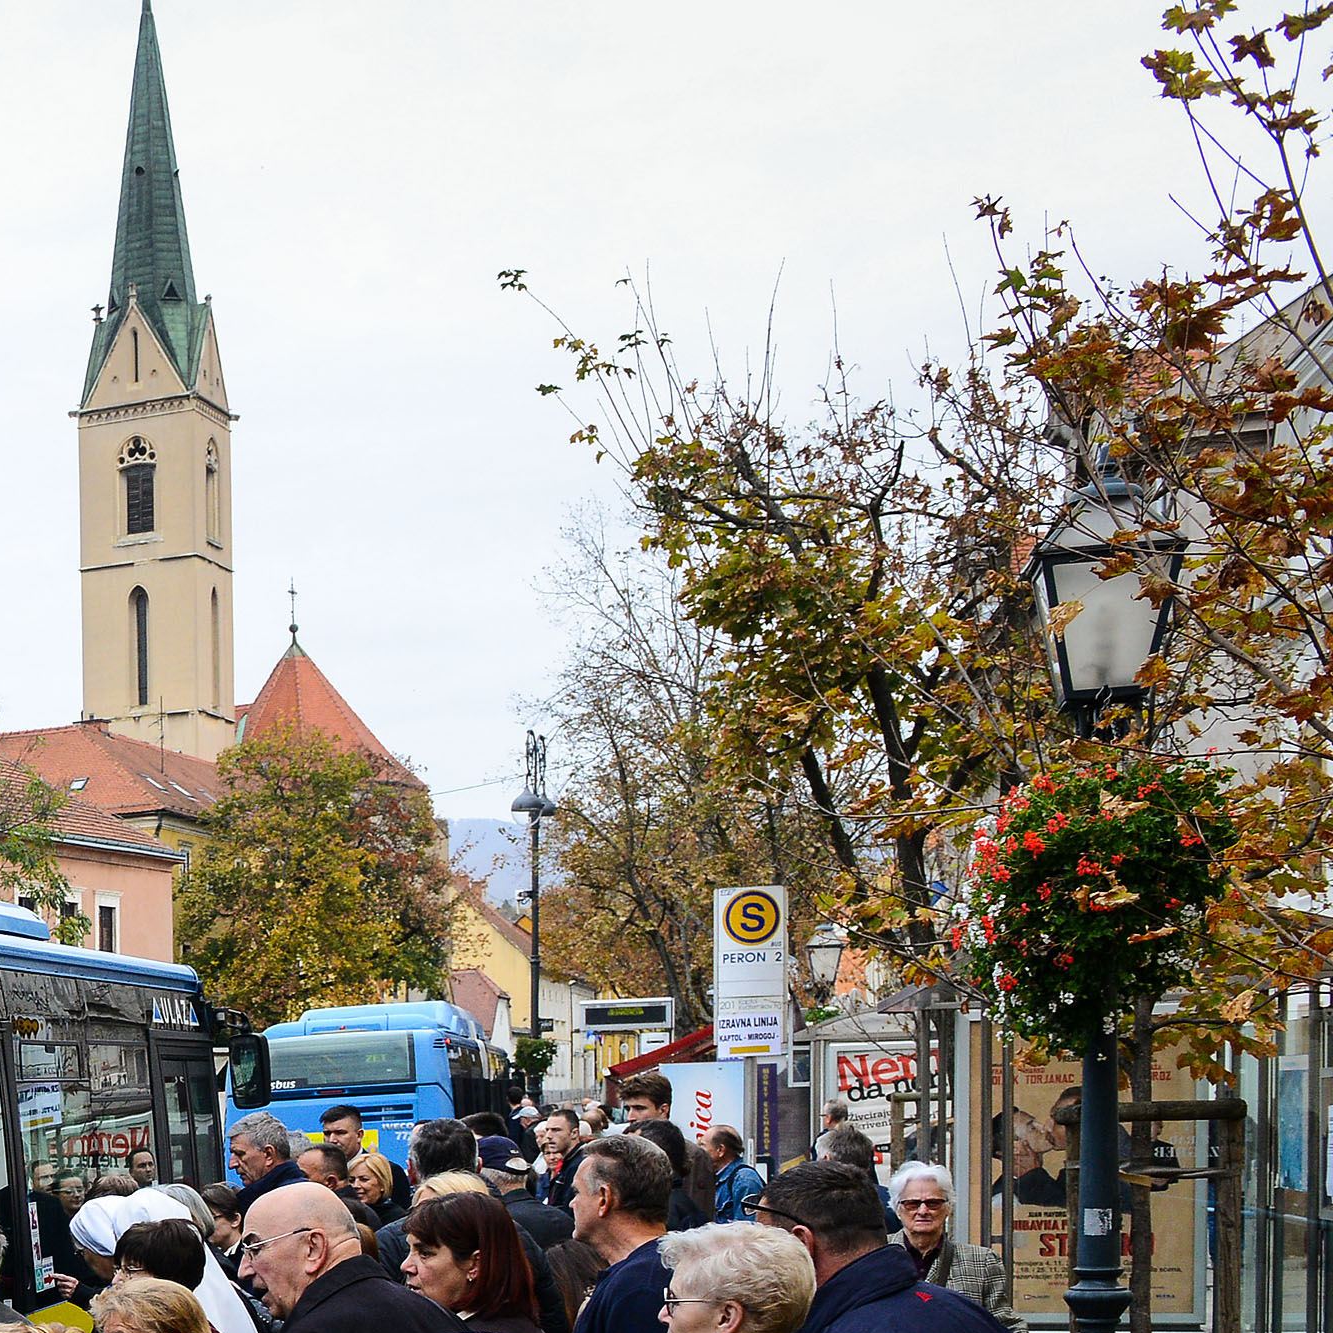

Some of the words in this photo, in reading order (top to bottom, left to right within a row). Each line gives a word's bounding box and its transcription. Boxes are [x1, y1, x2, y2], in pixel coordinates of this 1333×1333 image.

[740, 902, 765, 932] S
[722, 952, 766, 964] PERON
[774, 951, 782, 962] 2
[160, 997, 190, 1025] ULAZ
[719, 1017, 752, 1029] IZRAVNA
[753, 1016, 779, 1027] LINIJA
[719, 1034, 743, 1042] KAPTOL
[747, 1032, 776, 1041] MIROGOJ
[382, 1122, 415, 1131] IVECO
